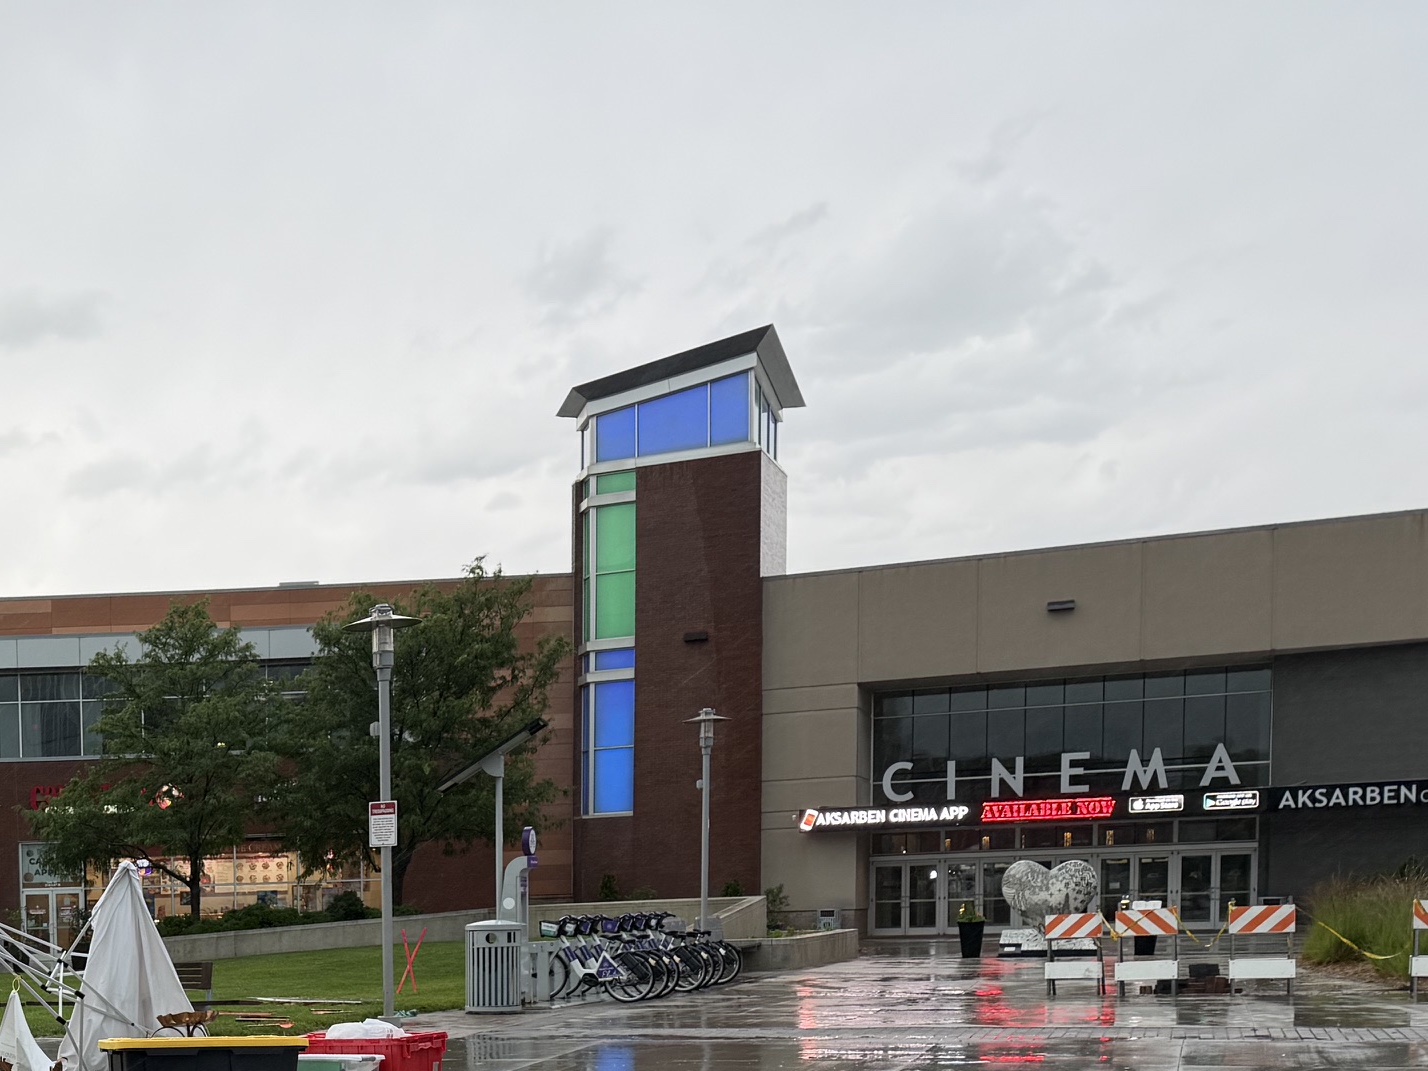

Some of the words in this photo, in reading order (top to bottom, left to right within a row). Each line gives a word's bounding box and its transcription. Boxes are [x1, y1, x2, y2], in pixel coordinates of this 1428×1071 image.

[882, 743, 1241, 802] CINEMA
[1216, 799, 1241, 807] Google
[1278, 784, 1417, 809] AKSARBEN
[815, 809, 886, 826] AKSARBEN
[889, 808, 938, 823] CINEMA
[939, 806, 969, 820] APP
[981, 802, 1072, 818] AVAILABLE
[1076, 800, 1116, 815] NOW
